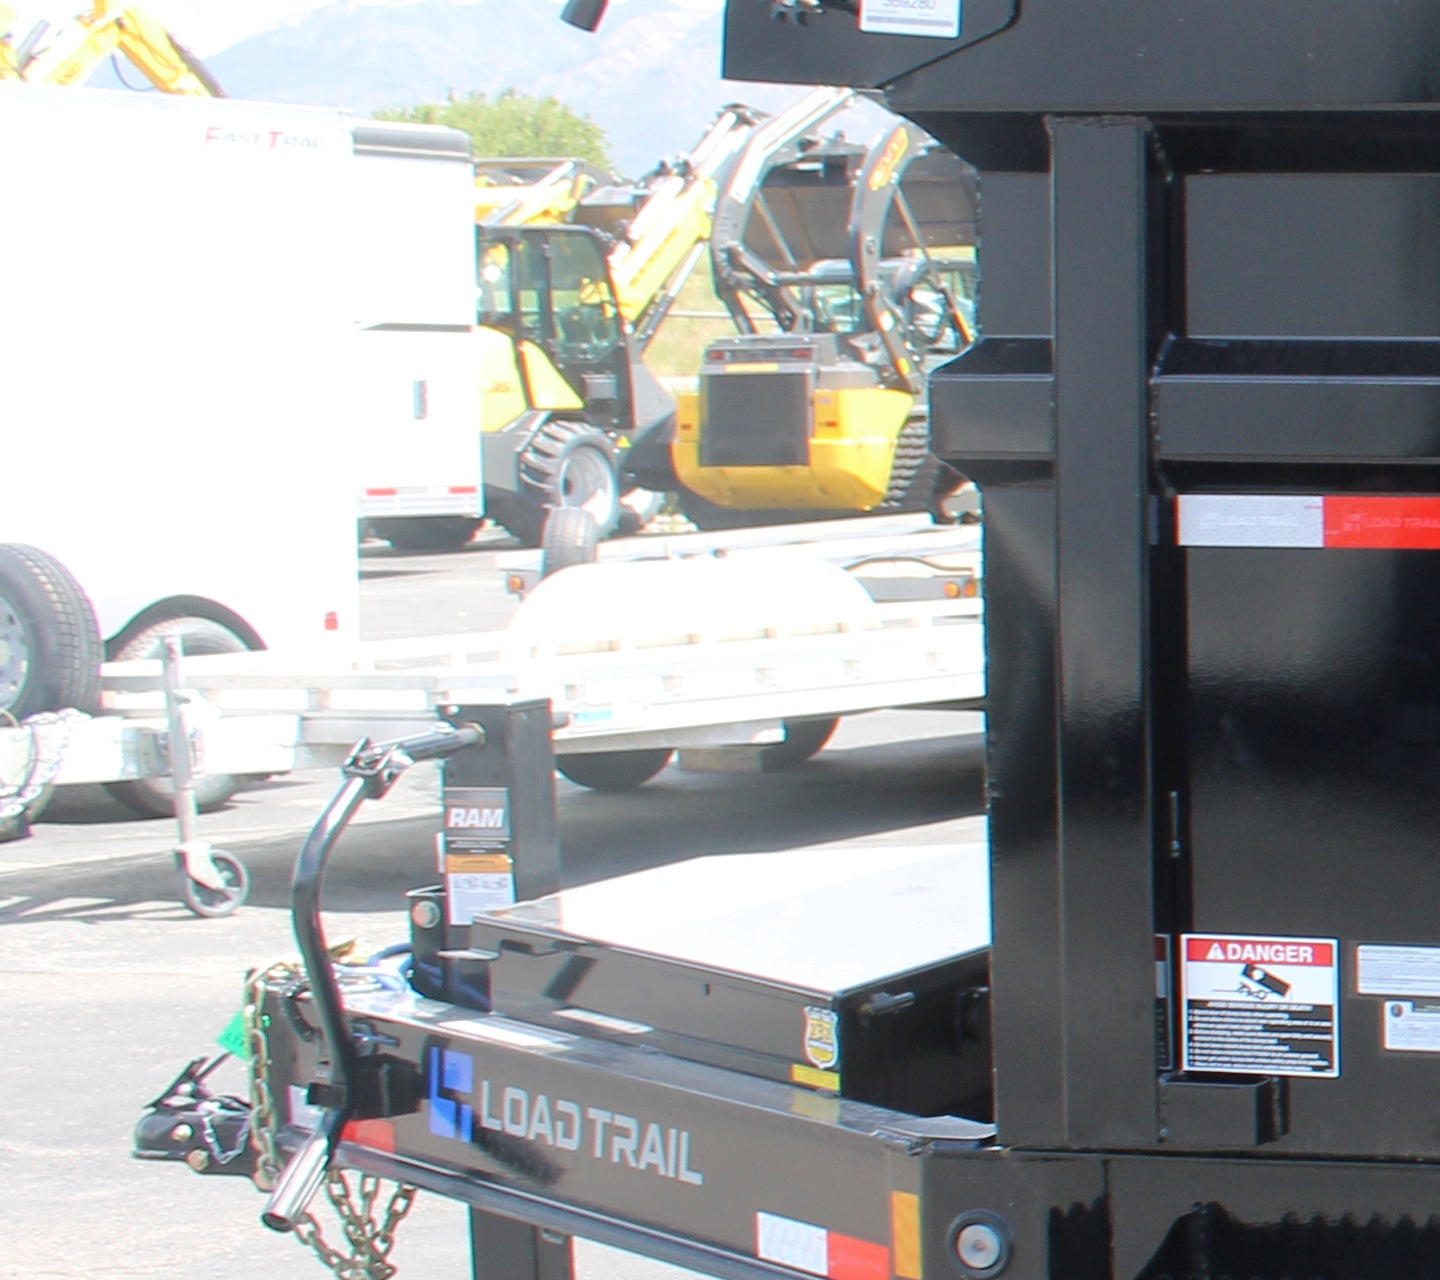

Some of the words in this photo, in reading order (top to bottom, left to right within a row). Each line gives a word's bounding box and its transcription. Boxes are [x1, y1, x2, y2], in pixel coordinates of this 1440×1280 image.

[1363, 517, 1402, 528] LOAD
[449, 808, 505, 828] RAM
[1227, 944, 1313, 963] DANGER
[480, 1080, 583, 1151] LOAD
[587, 1107, 704, 1186] TRAIL
